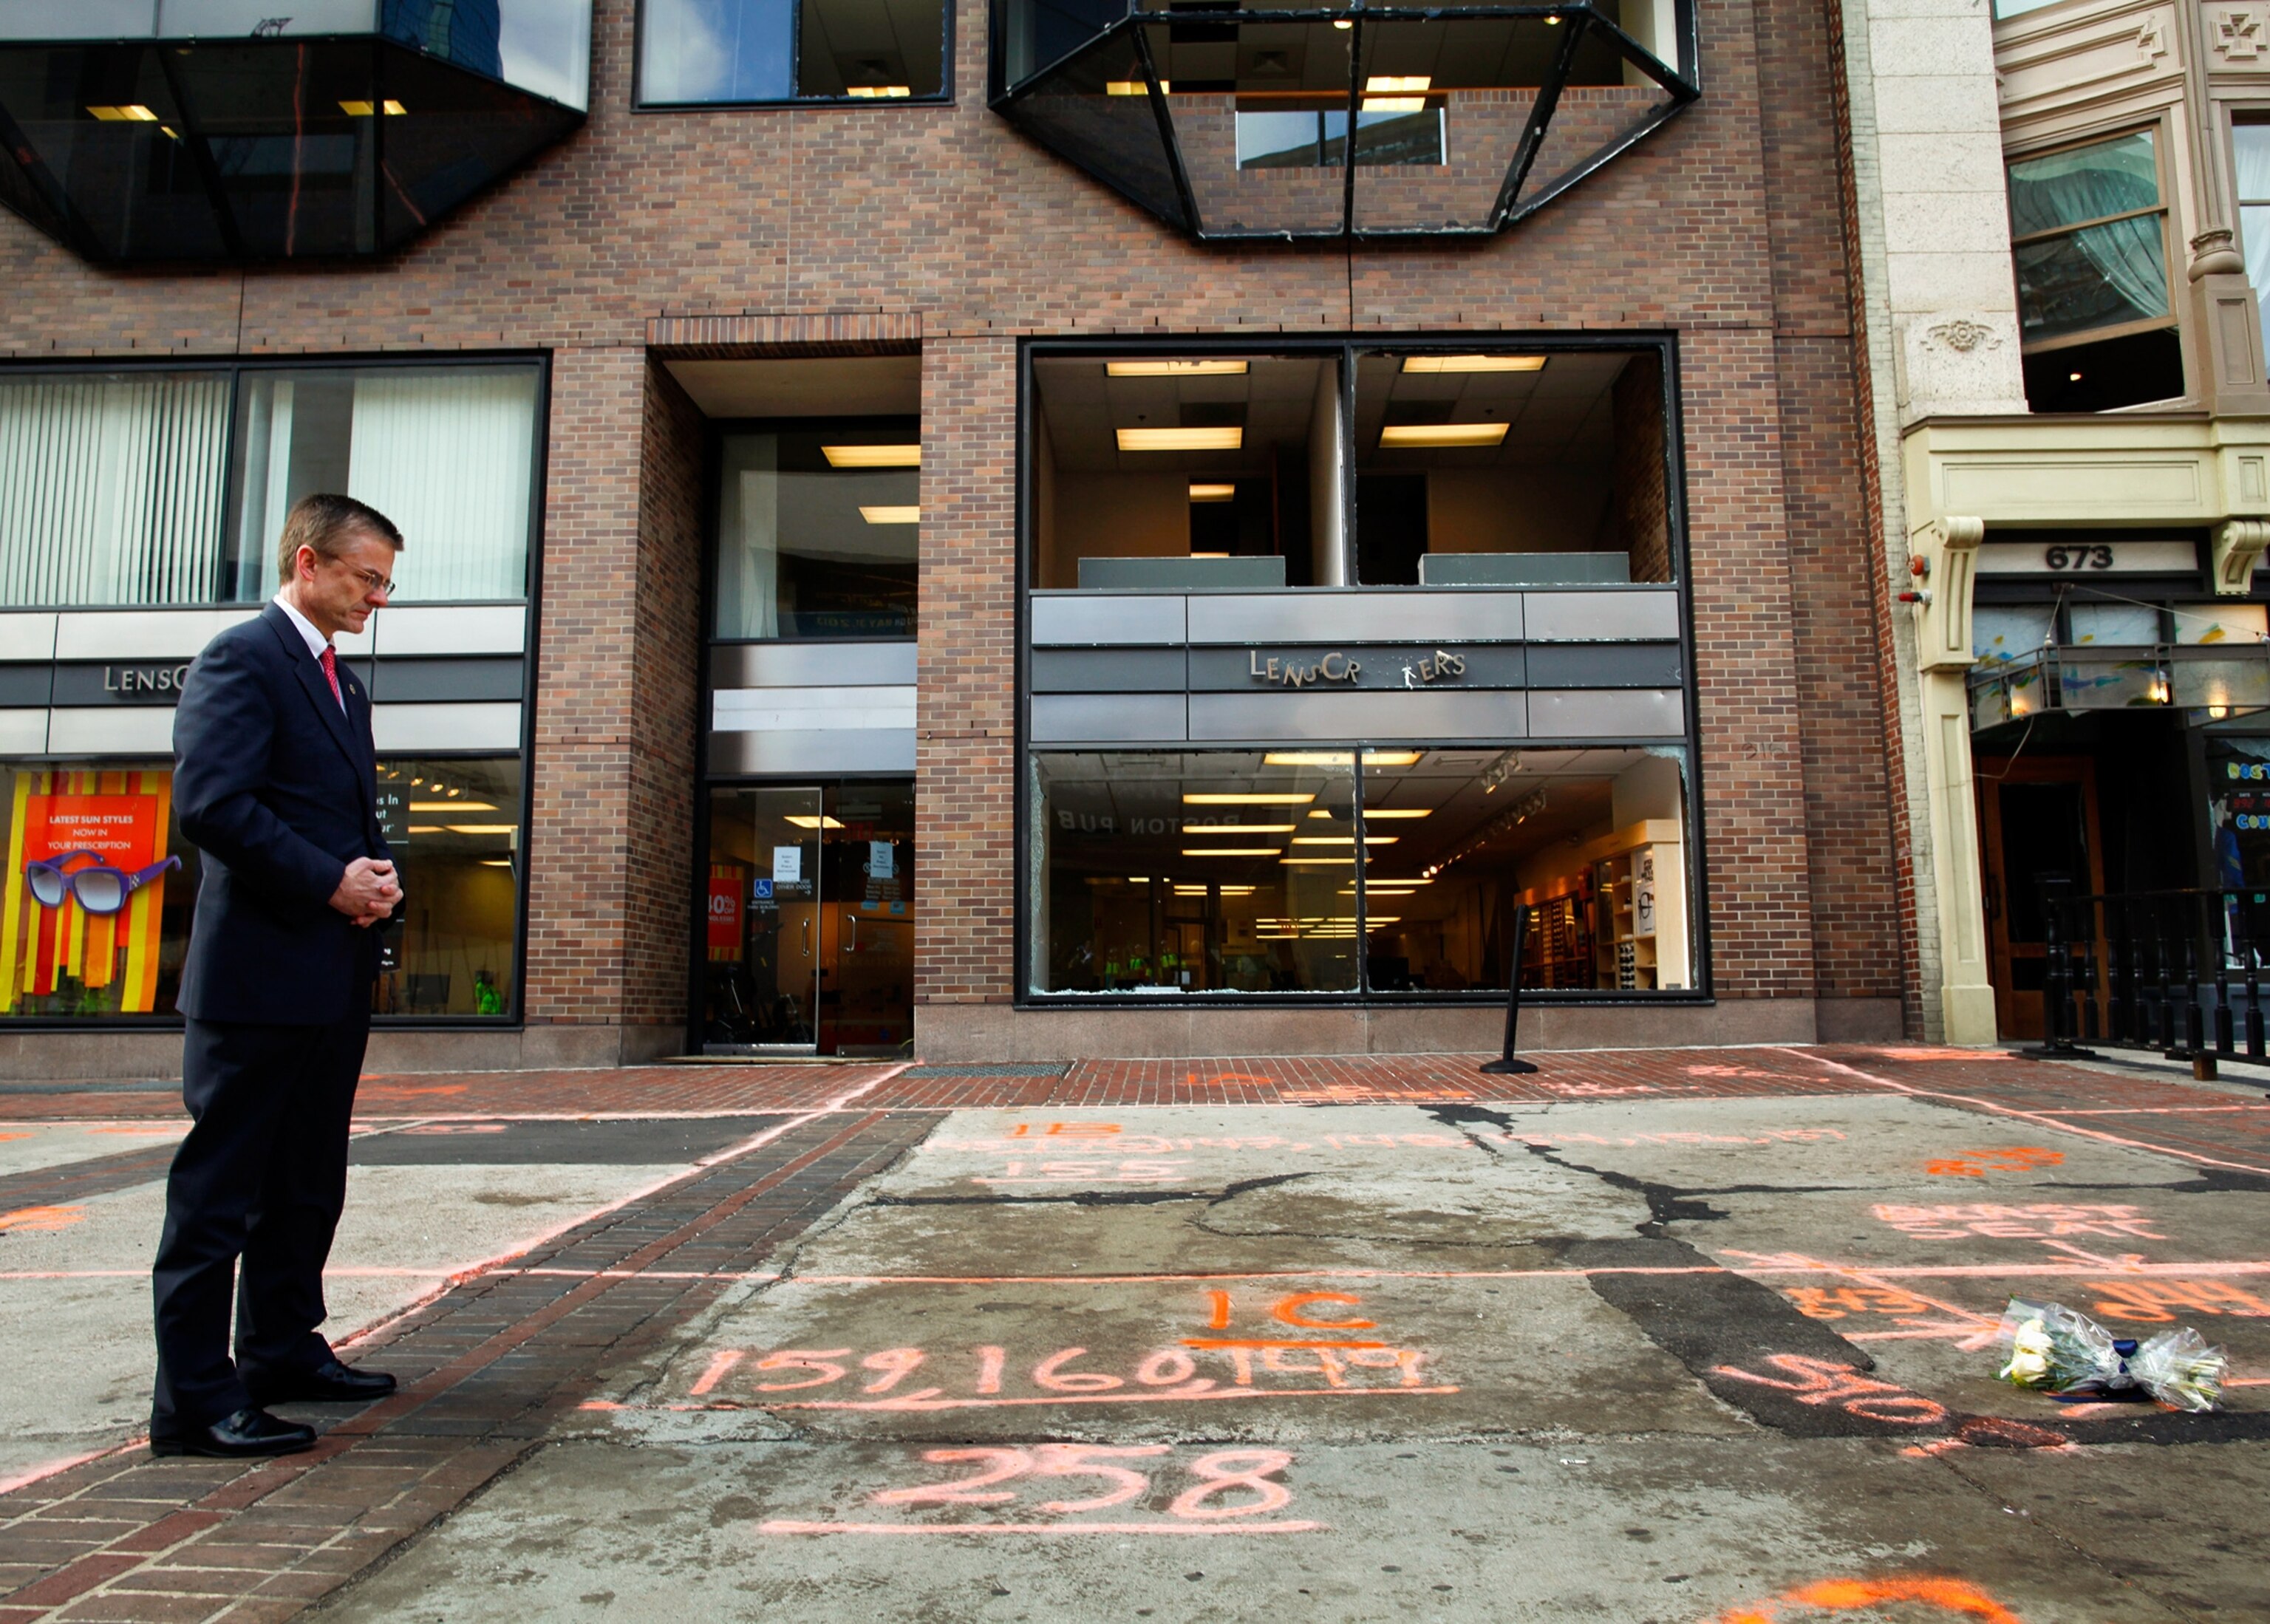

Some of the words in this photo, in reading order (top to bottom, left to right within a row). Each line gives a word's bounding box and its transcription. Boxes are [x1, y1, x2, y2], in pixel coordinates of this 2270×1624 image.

[2046, 545, 2113, 569] 673
[389, 794, 398, 805] In
[50, 816, 79, 824] LATEST
[81, 816, 100, 824] SUN
[103, 816, 133, 824] STYLES
[1006, 1159, 1194, 1178] 155
[1892, 1218, 2168, 1240] SEAT
[868, 1443, 1298, 1519] 258
